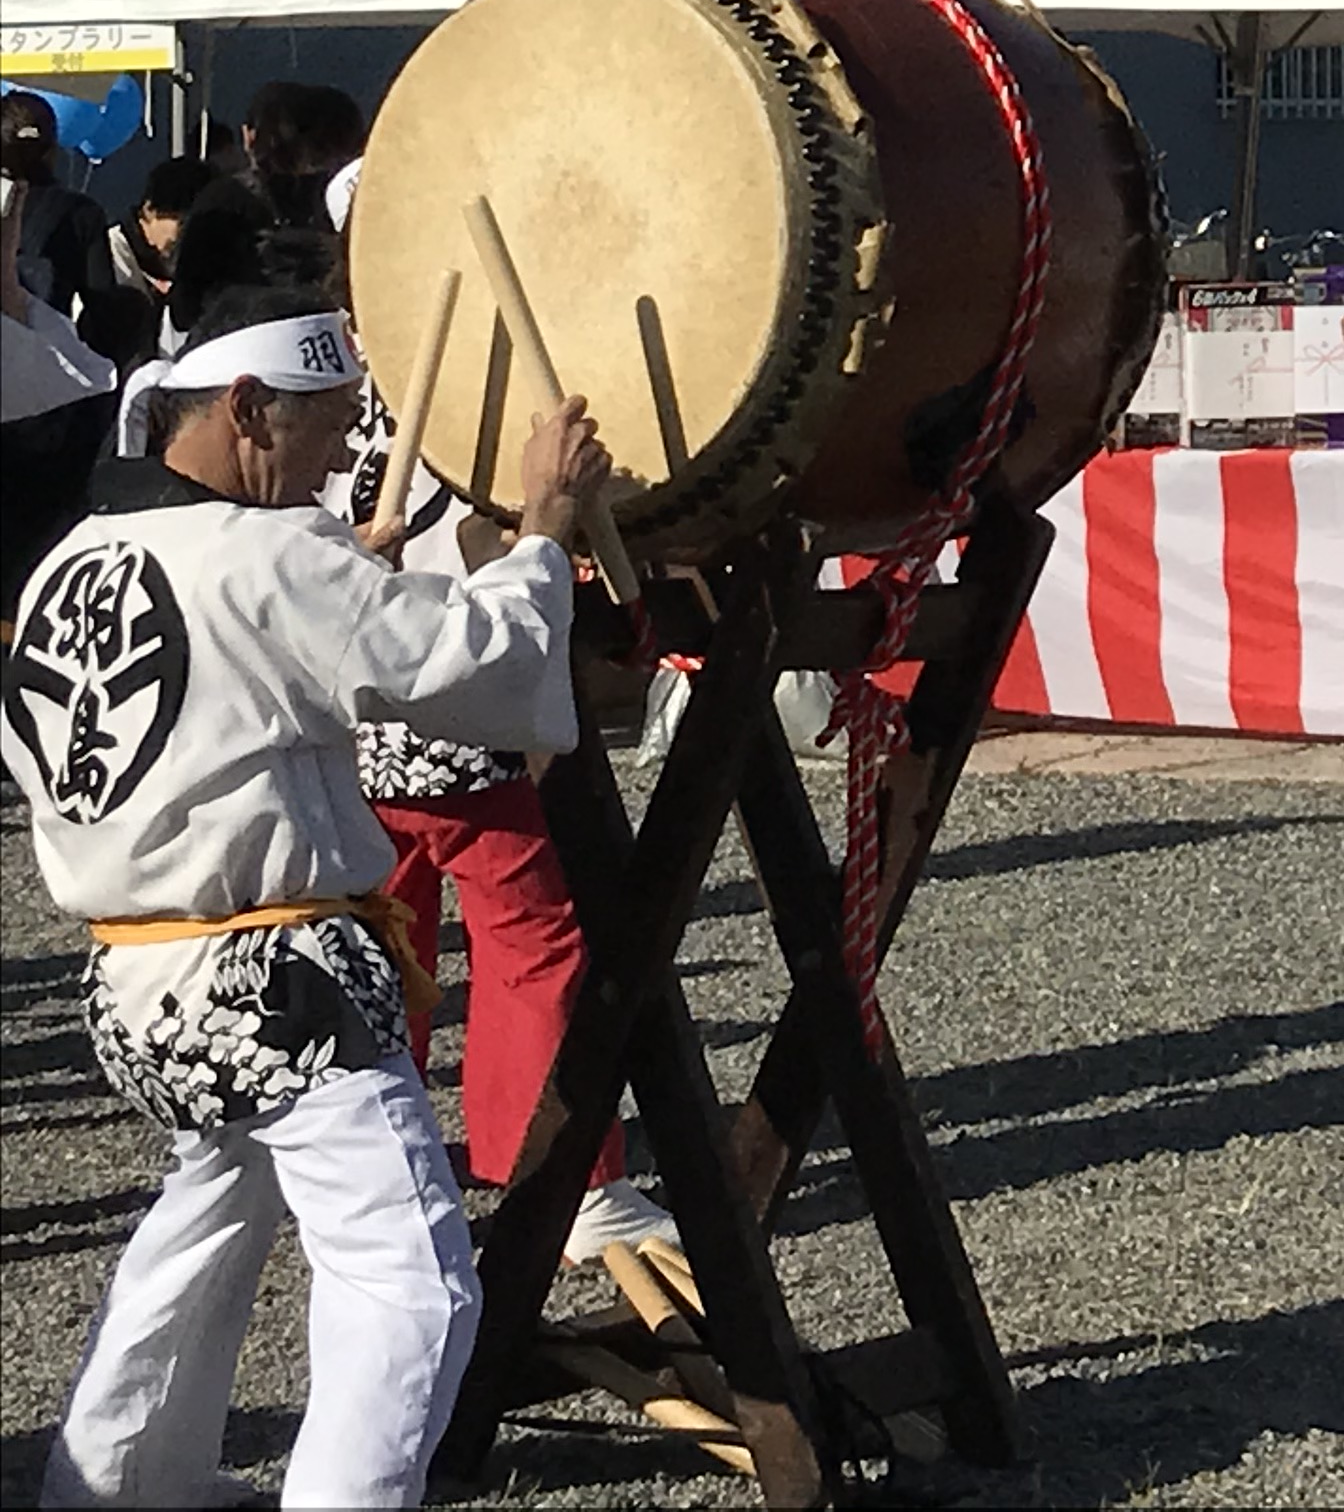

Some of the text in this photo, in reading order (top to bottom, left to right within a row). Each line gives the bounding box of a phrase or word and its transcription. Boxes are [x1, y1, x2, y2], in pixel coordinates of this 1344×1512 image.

[0, 26, 153, 54] タンプラリー
[297, 330, 344, 373] 羽
